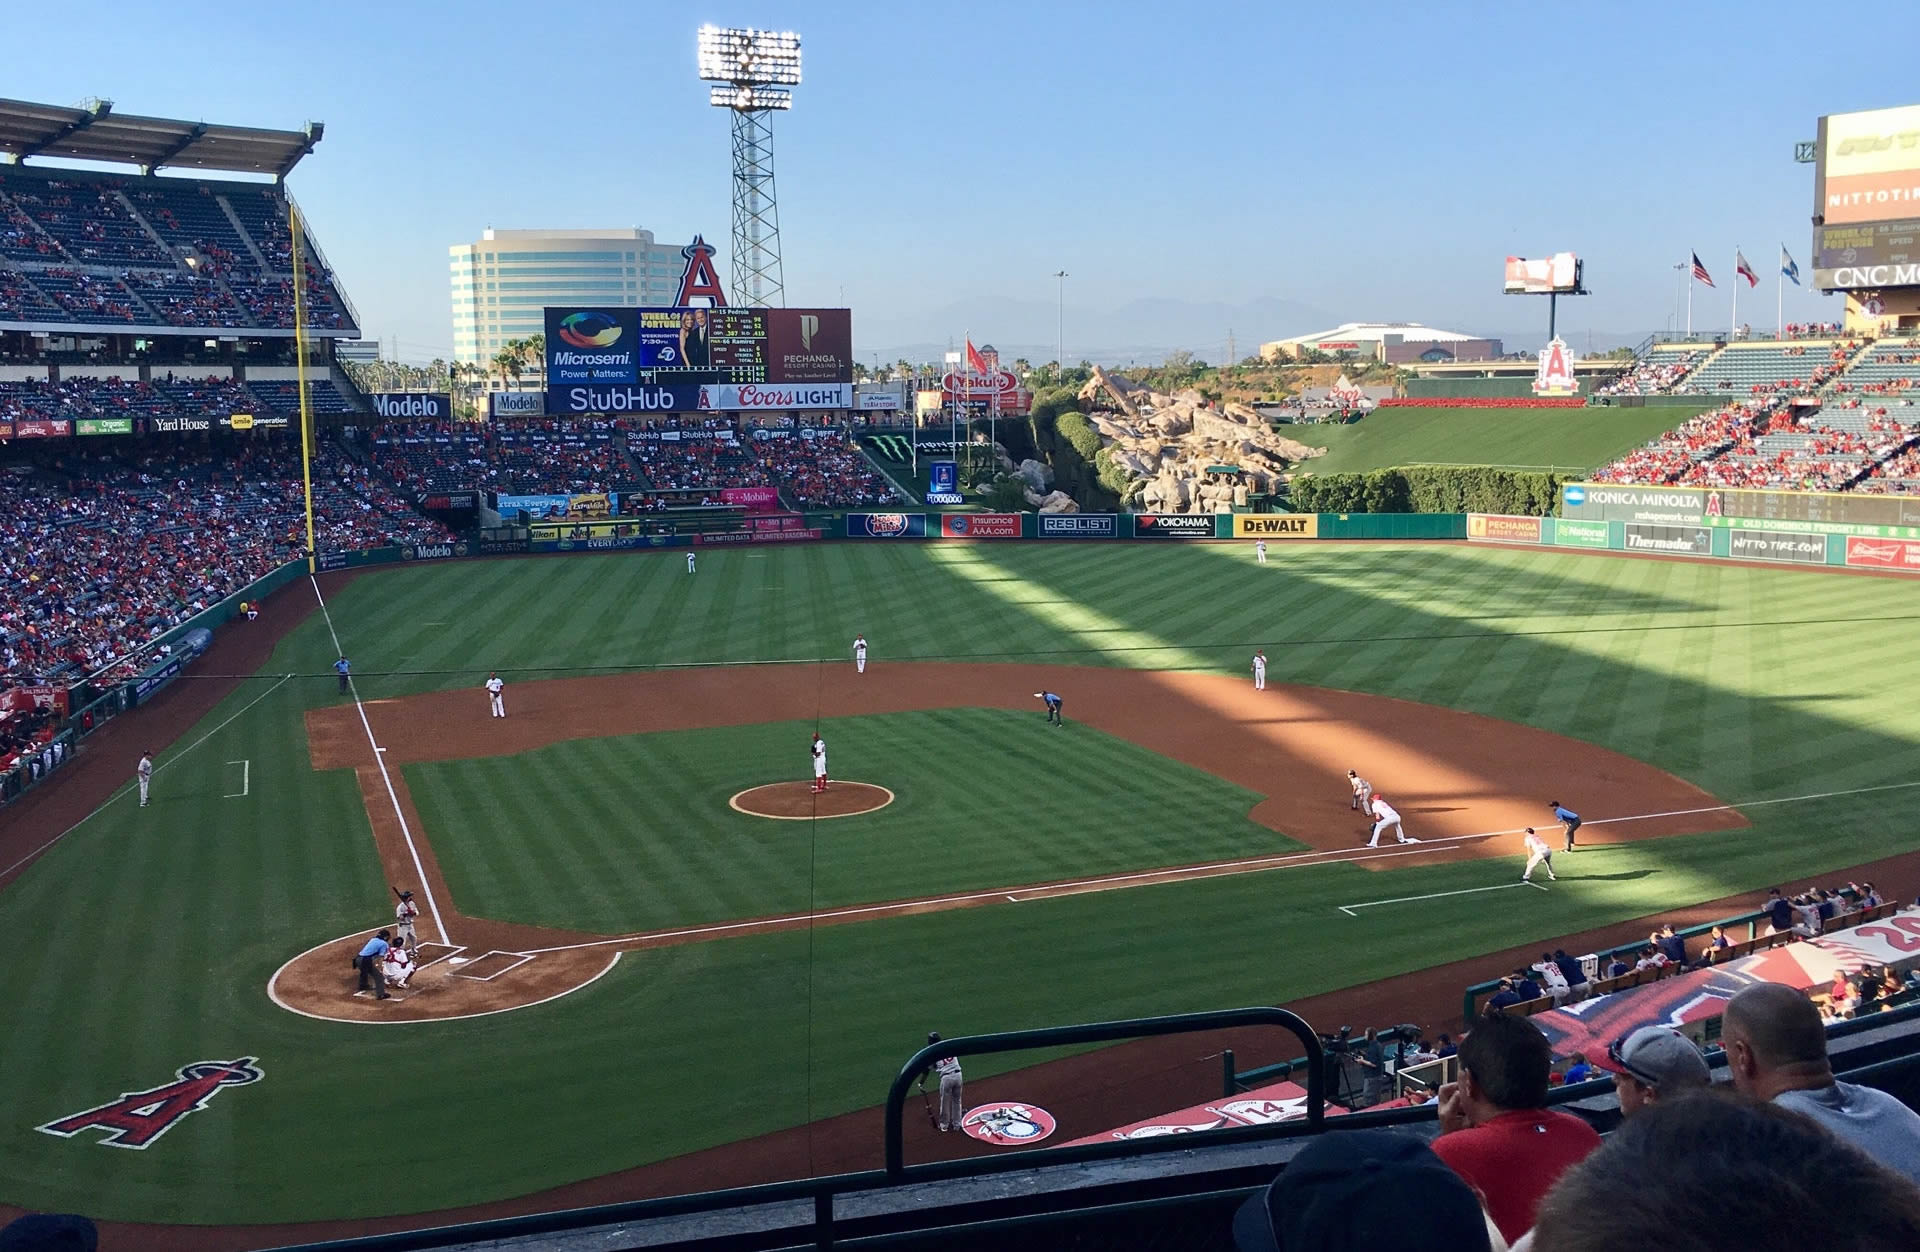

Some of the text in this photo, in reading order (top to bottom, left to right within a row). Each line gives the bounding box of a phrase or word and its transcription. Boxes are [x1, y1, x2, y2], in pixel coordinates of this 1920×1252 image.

[1834, 263, 1920, 287] CNC M
[641, 312, 669, 320] WHEEL
[641, 320, 681, 328] FORTUNE
[570, 388, 674, 411] StubHub
[738, 384, 842, 406] Coors LIGHT
[376, 395, 438, 417] Modelo
[501, 396, 538, 409] Modelo
[155, 418, 209, 431] Yard House
[253, 418, 287, 426] generation
[628, 432, 659, 440] StubHub
[1589, 491, 1700, 508] KONICA MINOLTA
[972, 516, 1013, 525] Insurance
[1156, 518, 1210, 527] YOKOHAMA
[1488, 520, 1537, 532] PECHANGA
[972, 527, 1013, 535] AAA.com
[1569, 526, 1606, 537] National
[1743, 519, 1880, 536] OLD DOMINION FREIGHT LINE
[784, 531, 814, 539] BASEBALL
[1629, 534, 1693, 550] Thermador
[1734, 539, 1823, 554] NITTO TIRE.COM
[418, 545, 451, 558] Modelo
